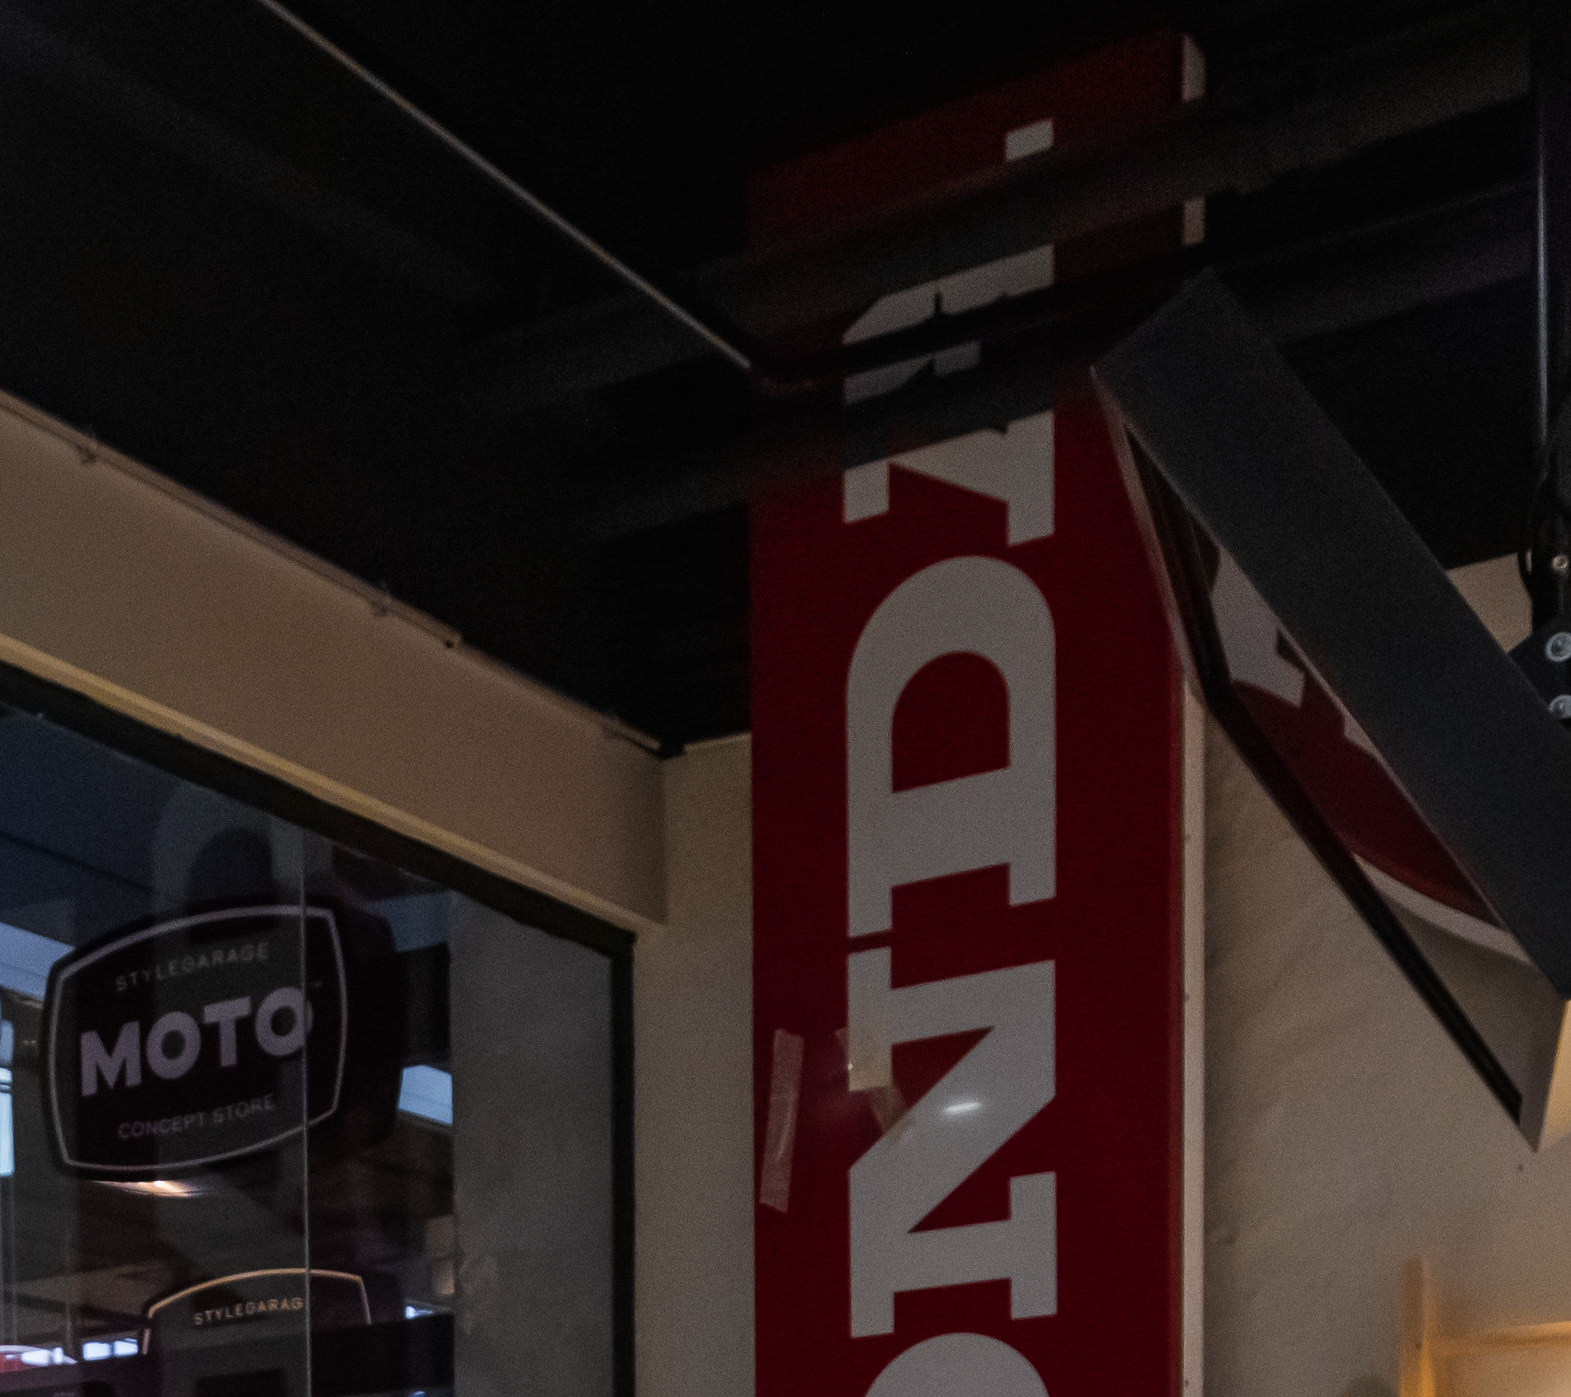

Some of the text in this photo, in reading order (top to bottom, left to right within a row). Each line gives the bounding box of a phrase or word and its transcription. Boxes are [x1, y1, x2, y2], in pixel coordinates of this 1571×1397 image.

[114, 942, 270, 993] STYLEGARAGE
[79, 986, 314, 1098] MOTO
[116, 1093, 276, 1141] CONCEPT STORE
[193, 1296, 305, 1326] STYLEGARAG
